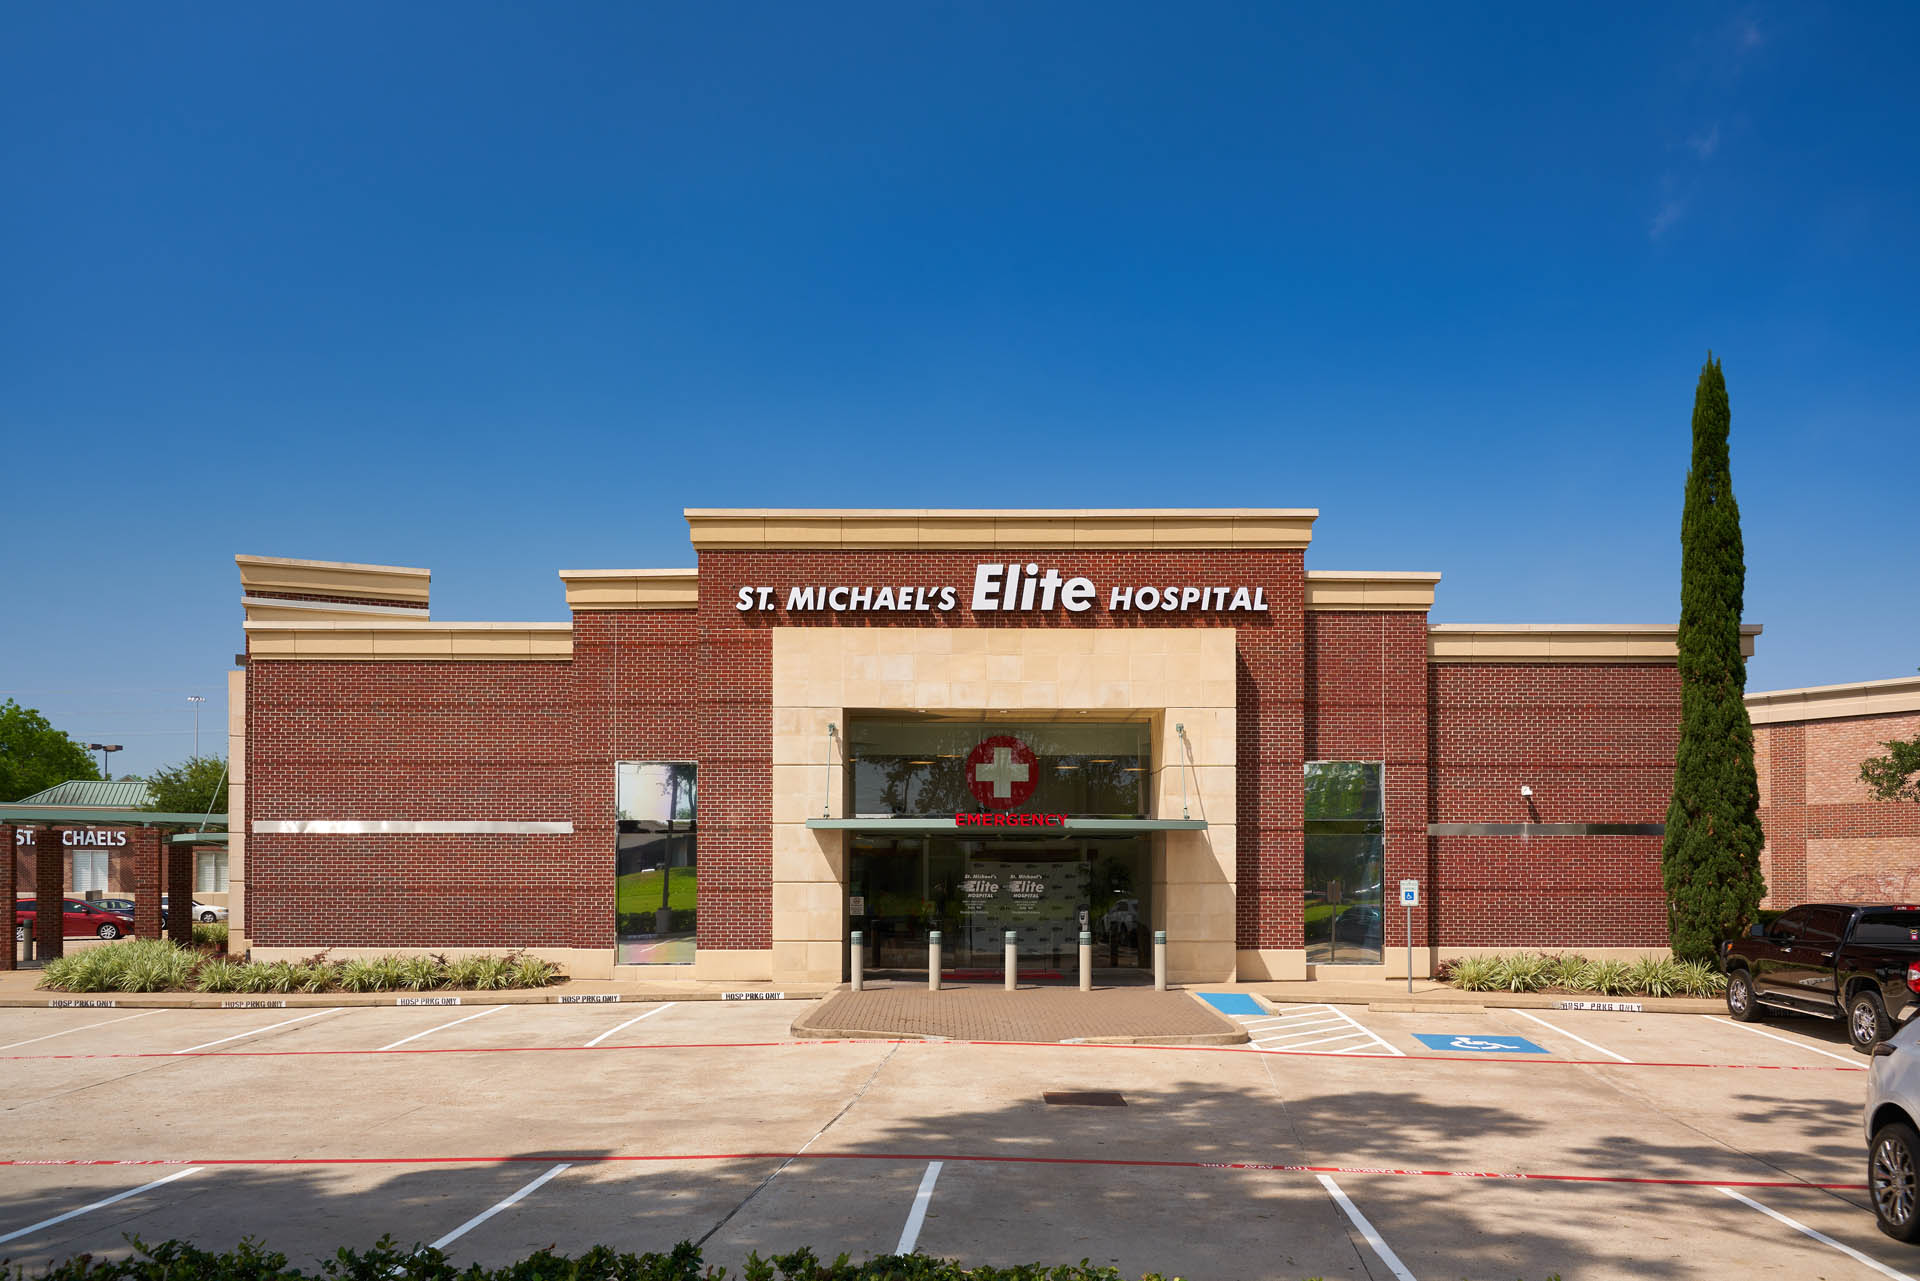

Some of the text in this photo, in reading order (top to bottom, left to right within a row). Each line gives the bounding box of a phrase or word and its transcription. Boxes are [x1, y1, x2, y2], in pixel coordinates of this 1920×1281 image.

[735, 563, 1268, 612] ST. MICHAEL'S Elite HOSPITAL
[955, 813, 1068, 826] EMERGENCY
[16, 829, 126, 846] ST. CHAEL'S
[966, 880, 999, 893] Elite
[1011, 880, 1044, 893] Elite
[1619, 1004, 1641, 1012] ONLY
